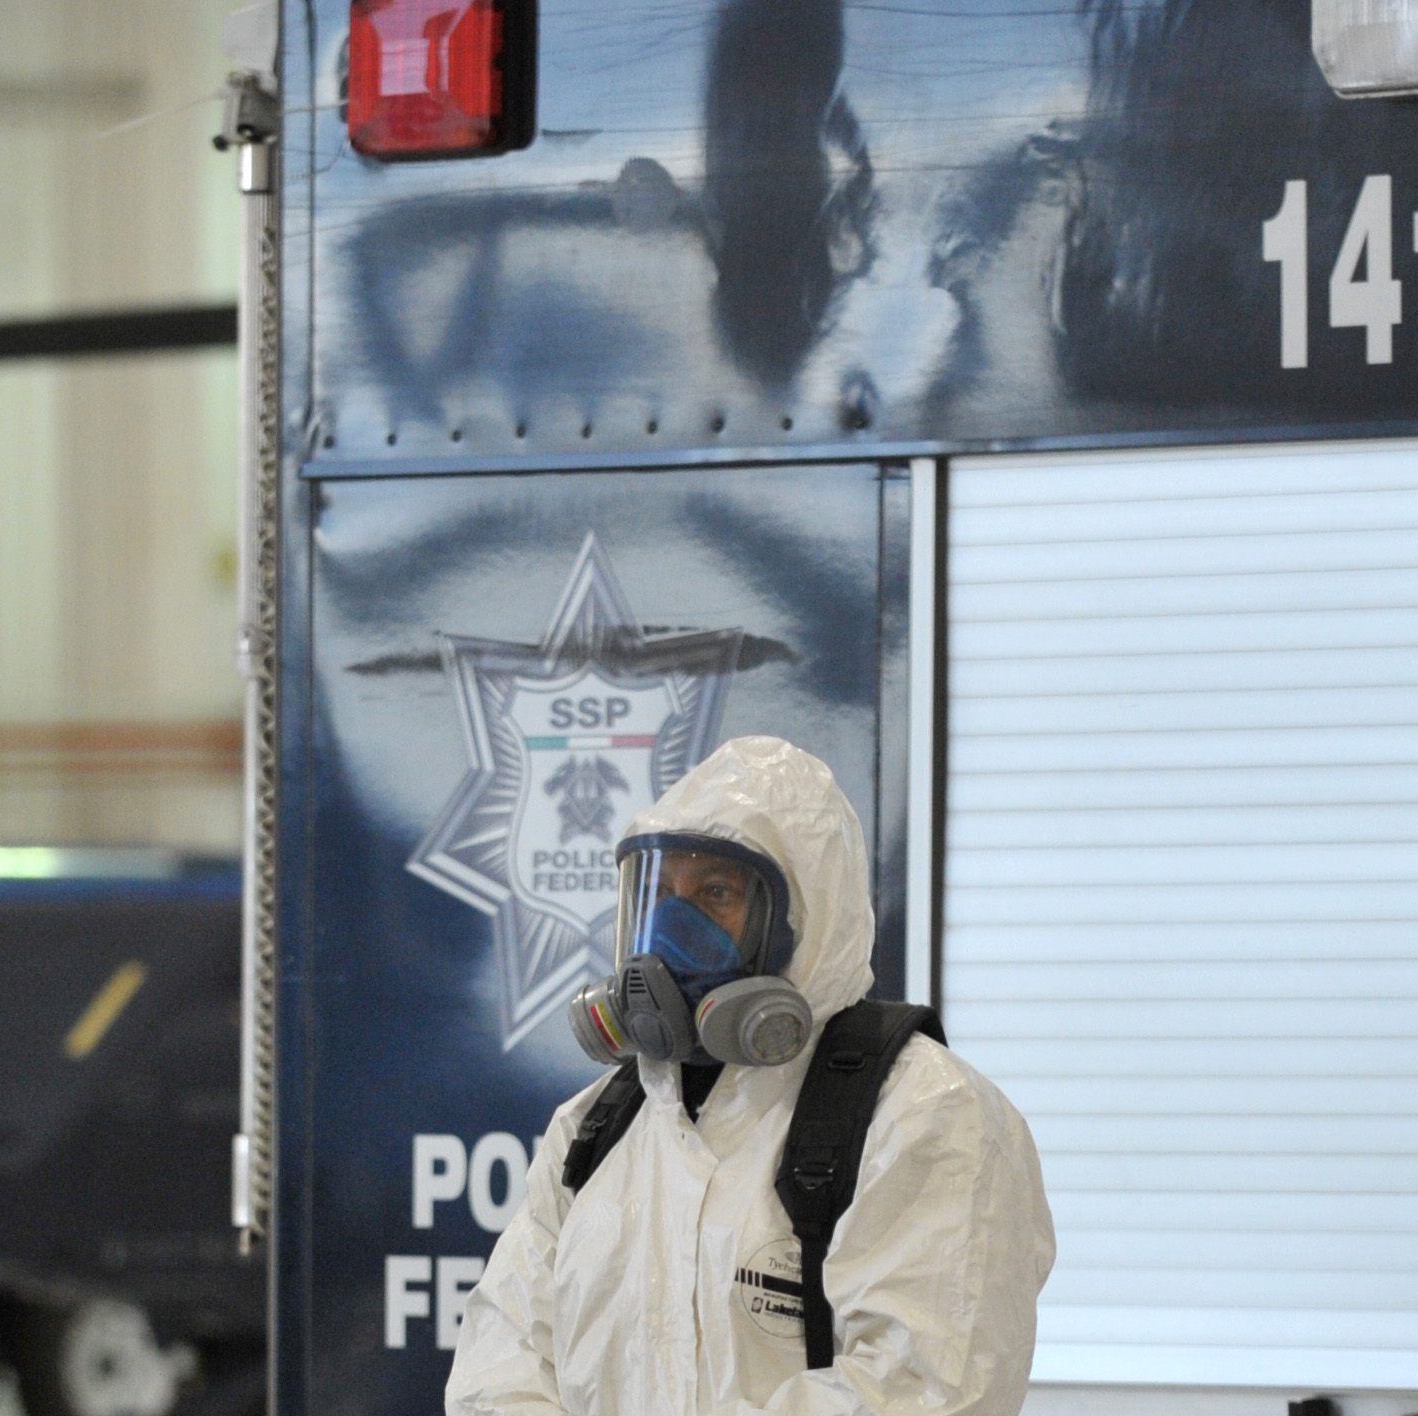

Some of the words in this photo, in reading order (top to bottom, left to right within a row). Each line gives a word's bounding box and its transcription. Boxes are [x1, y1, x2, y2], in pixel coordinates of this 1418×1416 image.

[549, 697, 631, 729] SSP
[533, 850, 615, 870] POLIC
[533, 872, 618, 892] FEDER
